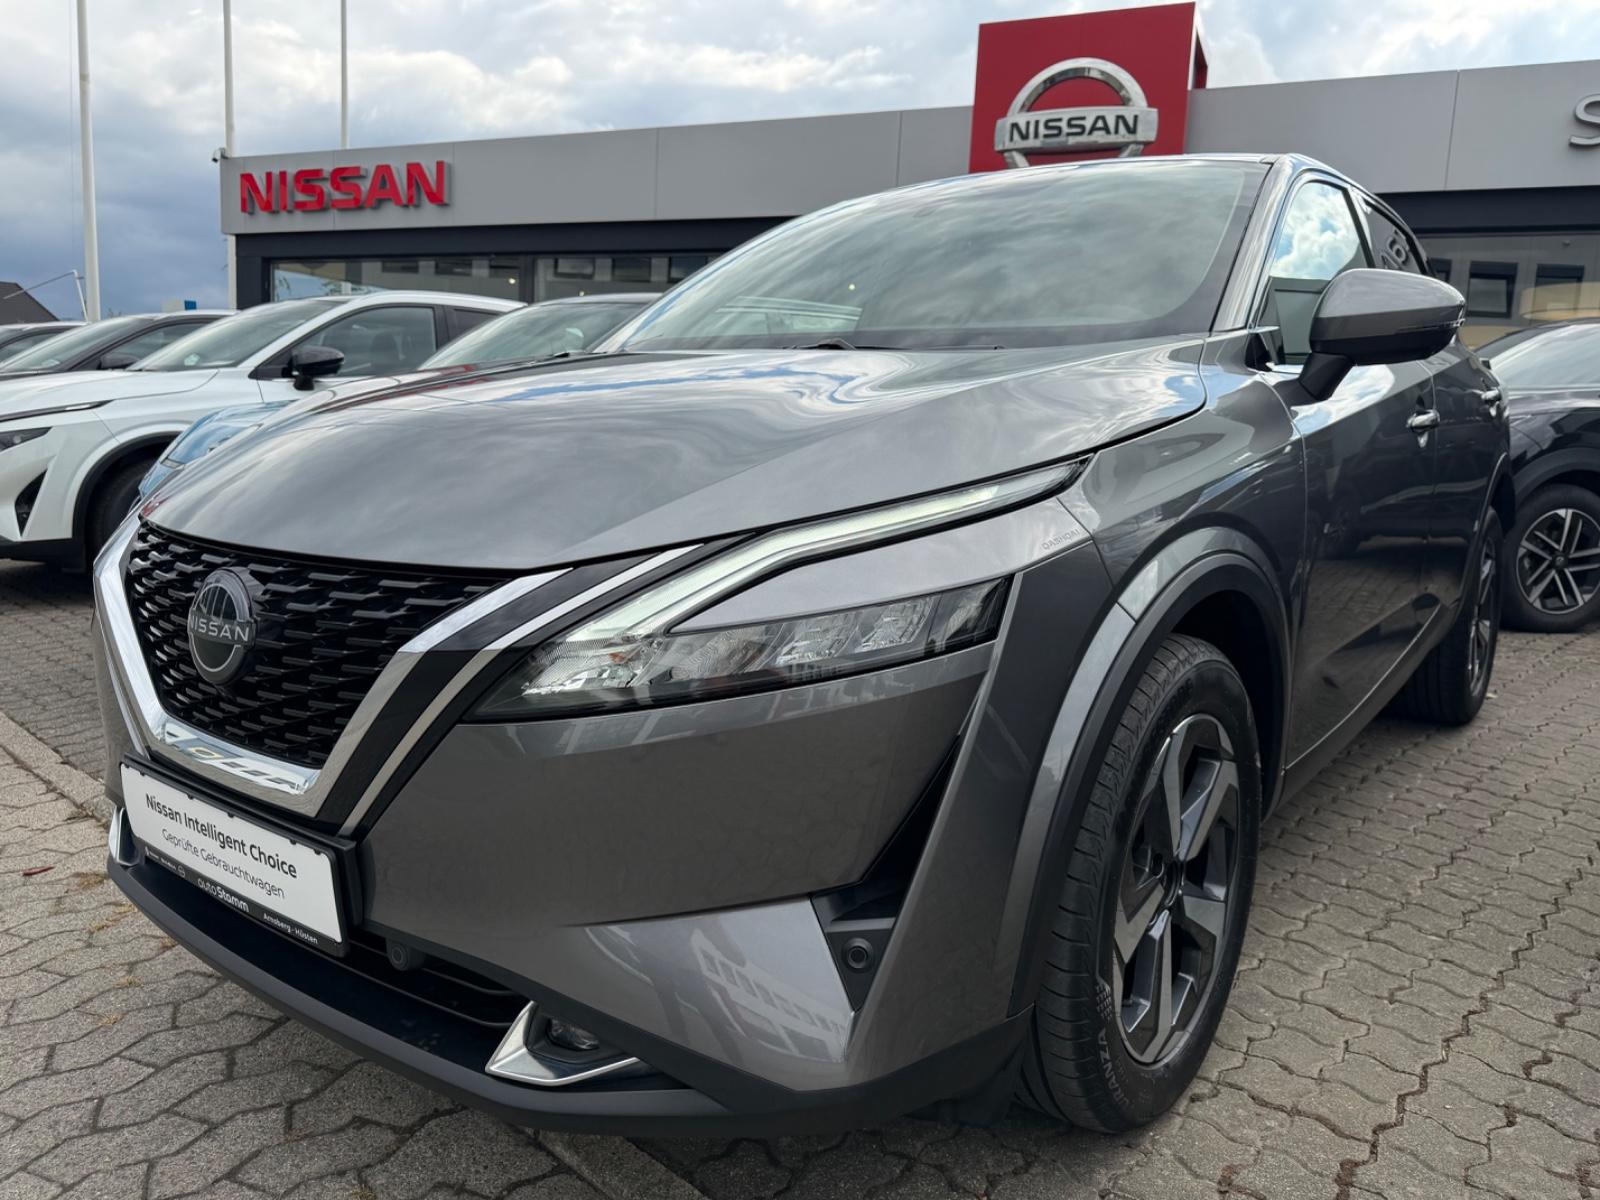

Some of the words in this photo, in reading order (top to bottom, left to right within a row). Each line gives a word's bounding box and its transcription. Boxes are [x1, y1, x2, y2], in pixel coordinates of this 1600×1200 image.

[1009, 114, 1139, 143] NISSAN
[240, 160, 446, 214] NISSAN
[189, 614, 250, 642] NISSAN
[146, 793, 182, 825] Nissan
[184, 812, 248, 857] Intelligent
[250, 844, 298, 879] Choice
[161, 828, 200, 858] Geprüfte
[200, 848, 286, 899] Gebrauchtwagen
